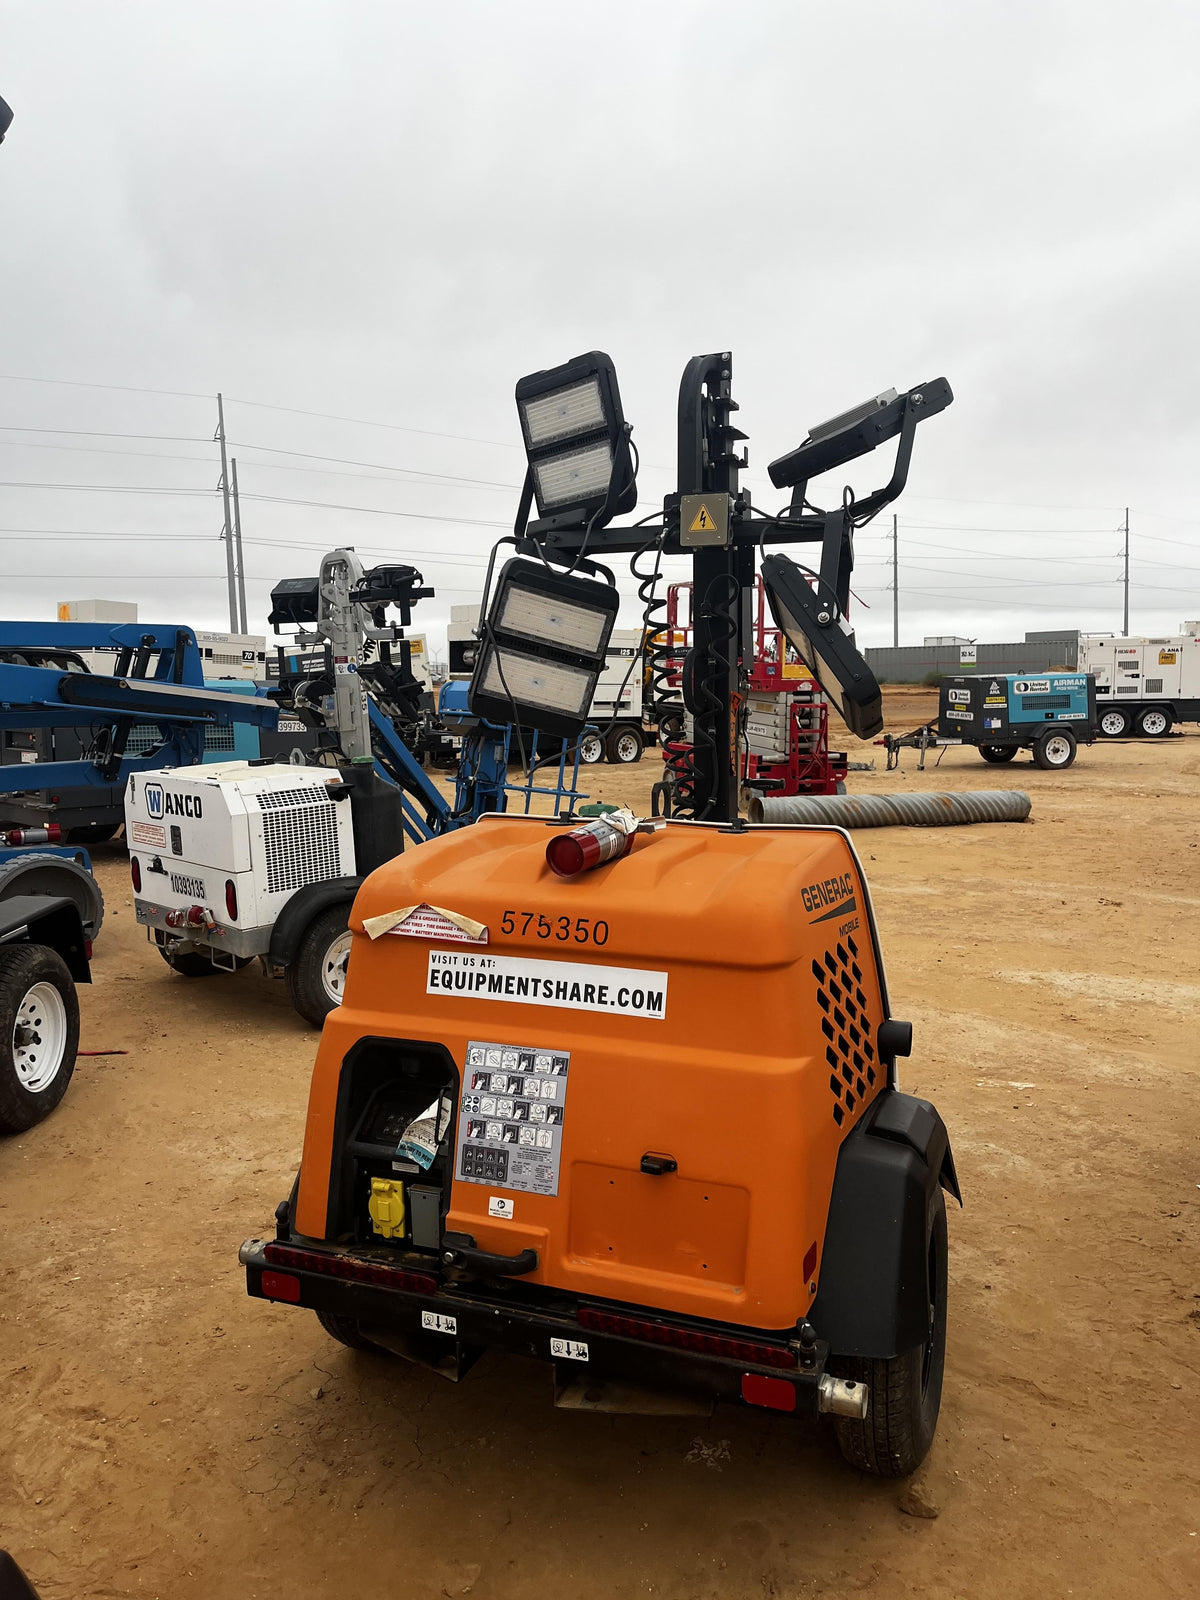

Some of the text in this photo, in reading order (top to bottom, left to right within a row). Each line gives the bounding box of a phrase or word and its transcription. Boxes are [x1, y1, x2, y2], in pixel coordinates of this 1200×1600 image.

[244, 652, 253, 660] 70
[620, 648, 631, 656] 125
[1053, 678, 1086, 686] AIRMAN
[147, 789, 203, 819] WANCO
[170, 873, 205, 900] 10393135
[801, 872, 858, 913] GENERAC
[500, 910, 609, 946] 575350
[839, 917, 860, 938] MOBILE
[431, 954, 496, 968] VISIT US AT:
[430, 968, 664, 1012] EQUIPMENTSHARE.COM
